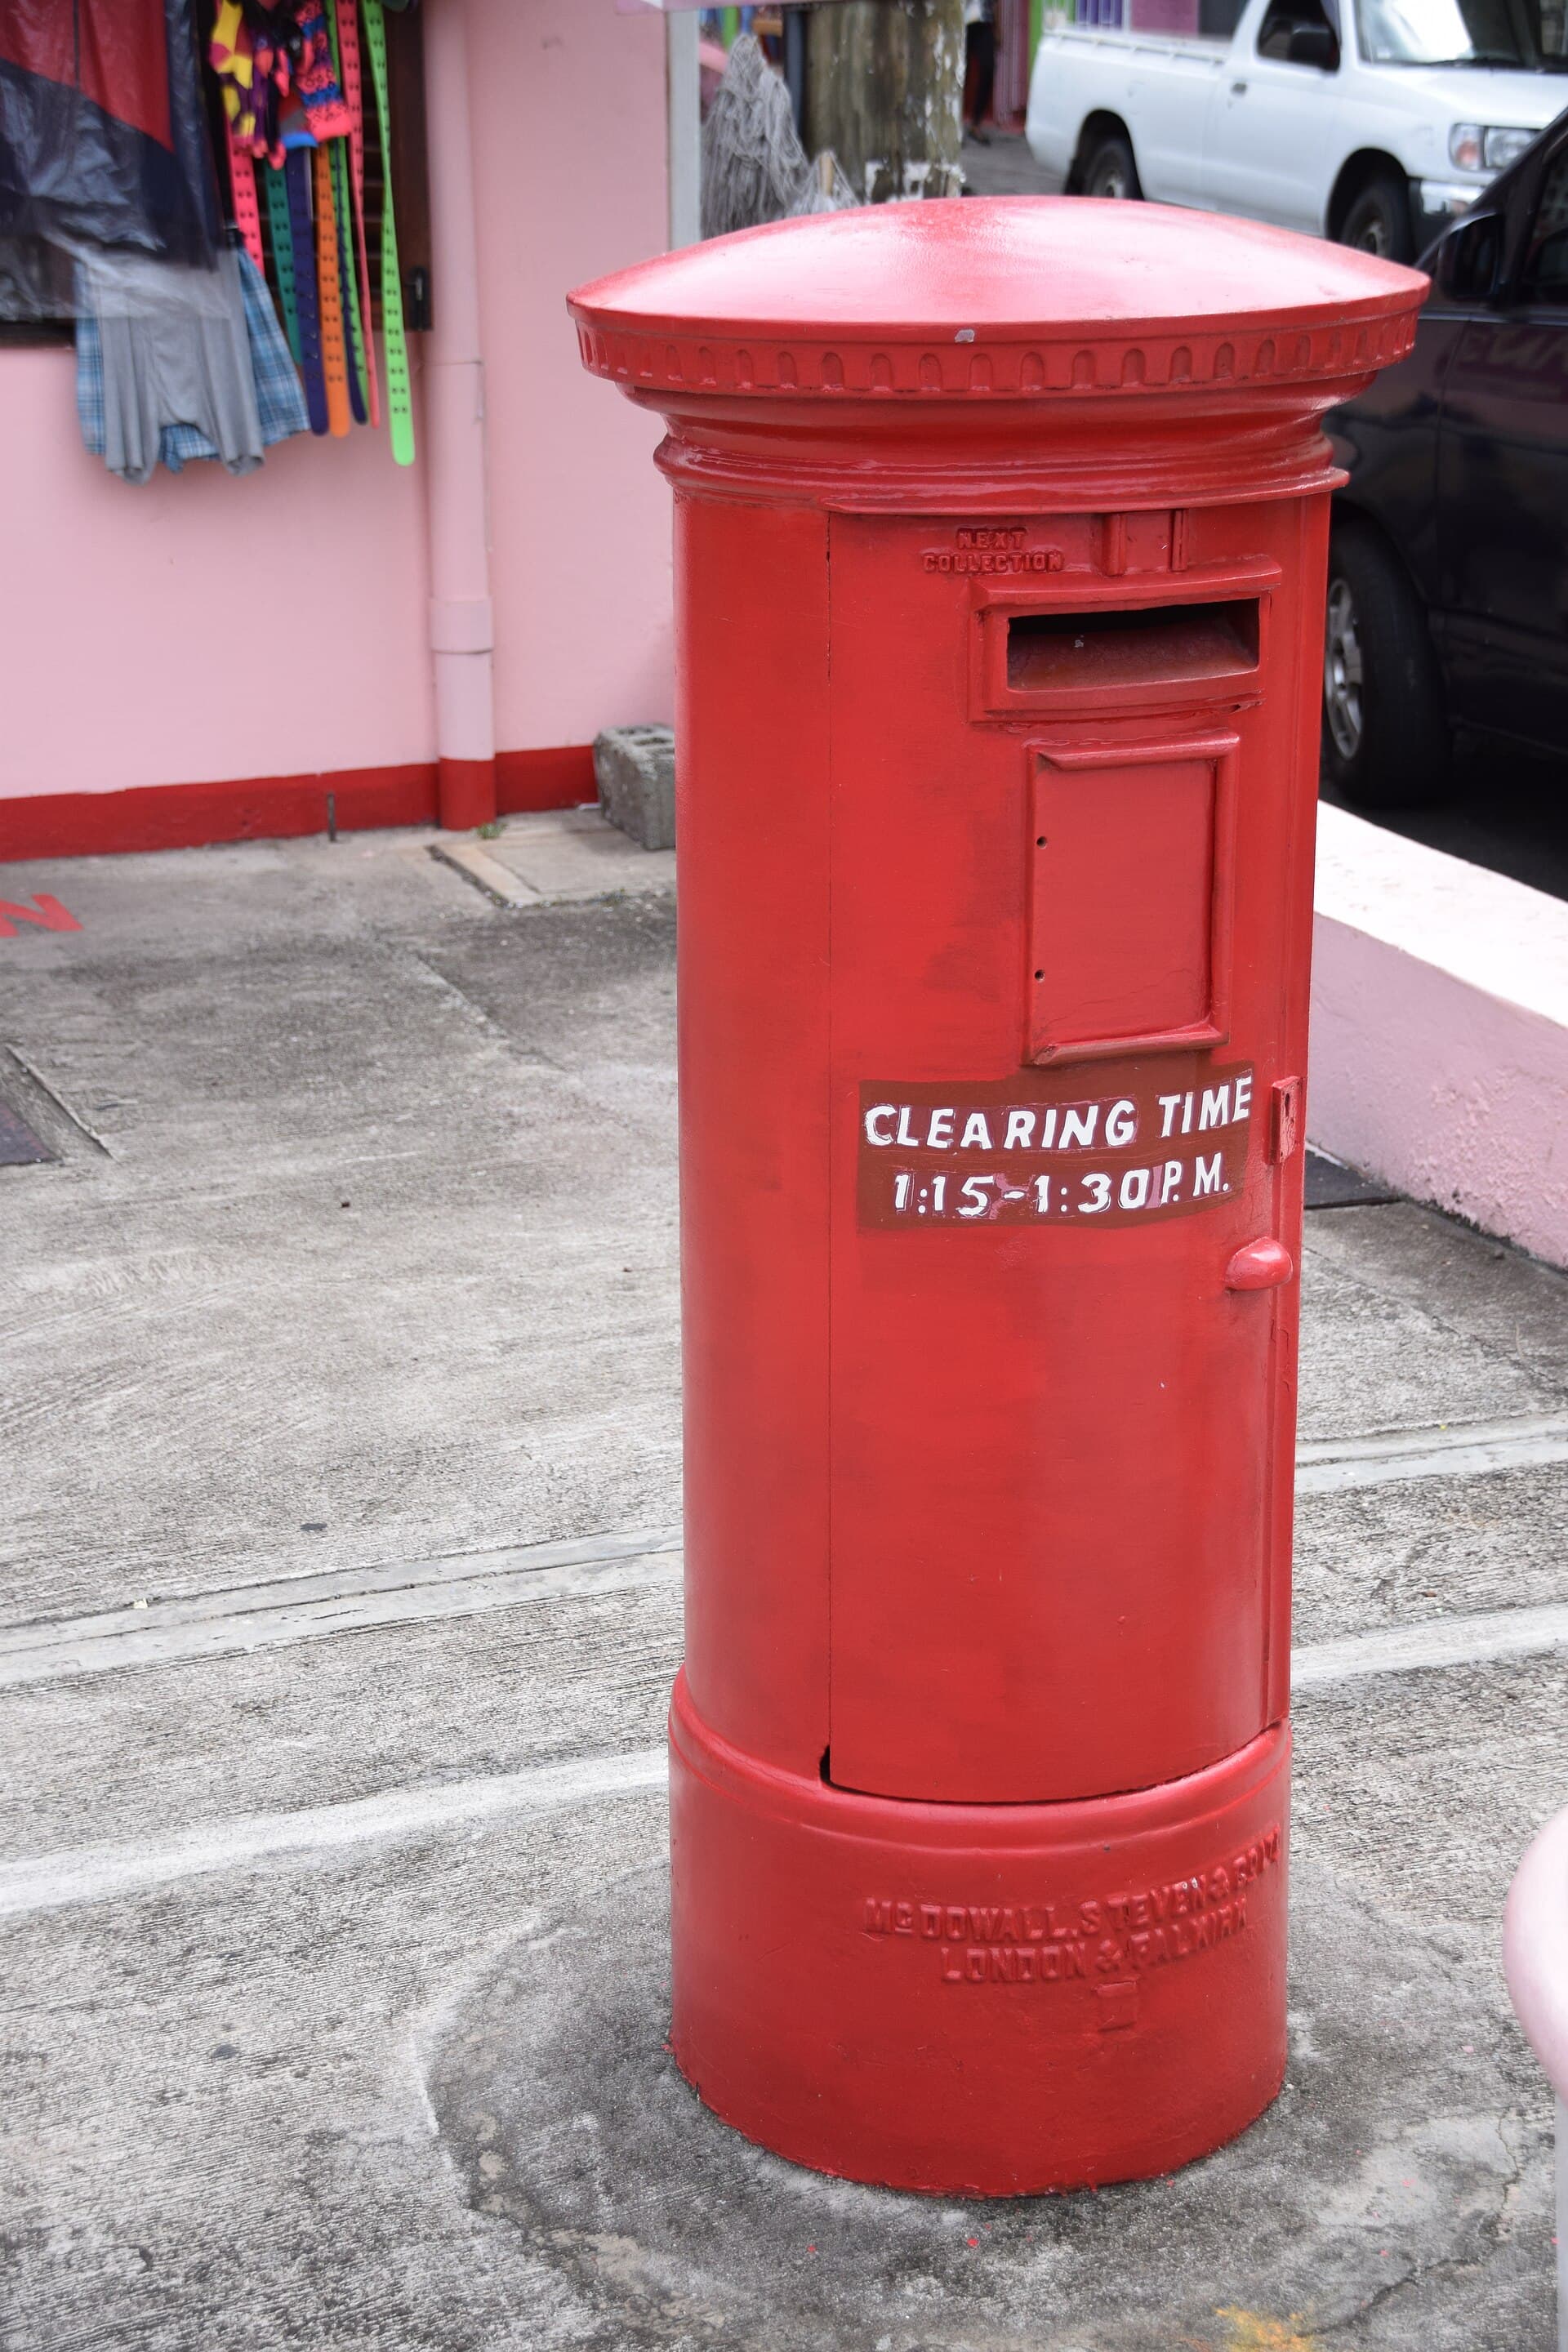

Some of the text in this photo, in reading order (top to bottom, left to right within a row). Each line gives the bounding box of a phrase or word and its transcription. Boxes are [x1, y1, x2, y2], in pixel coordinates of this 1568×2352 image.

[922, 550, 1065, 573] COLLECTION
[956, 527, 1027, 550] NEXT
[864, 1075, 1253, 1150] CLEARING TIME
[941, 1942, 1086, 1983] LONDON
[1129, 1896, 1247, 1970] FALKIRK
